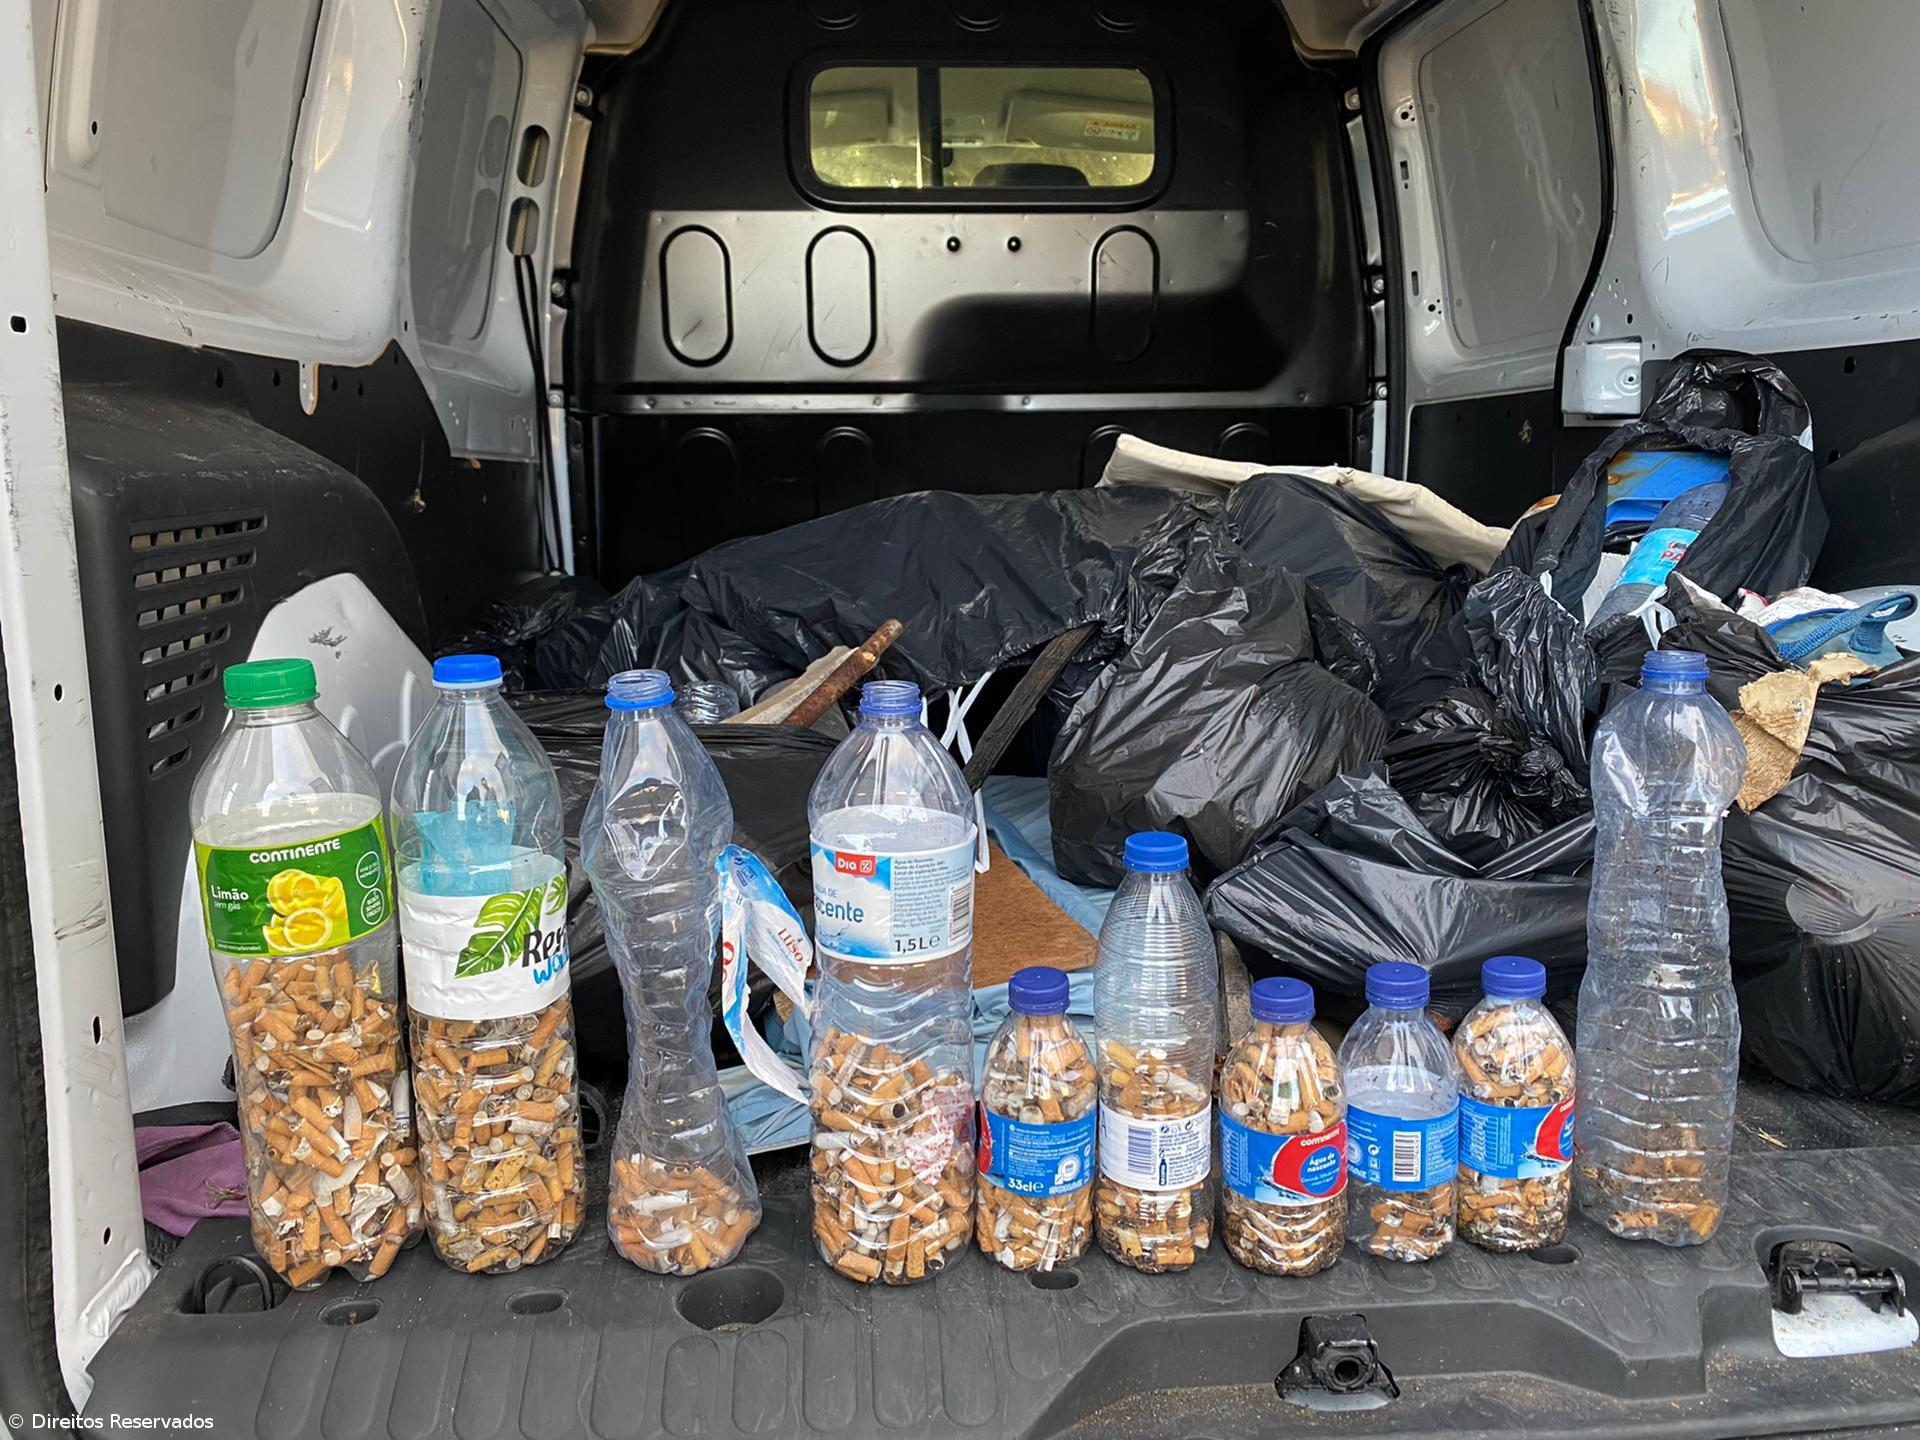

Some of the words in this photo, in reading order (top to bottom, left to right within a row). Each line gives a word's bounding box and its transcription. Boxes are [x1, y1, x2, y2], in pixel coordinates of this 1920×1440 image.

[210, 884, 249, 901] Limão
[828, 887, 838, 898] DE
[1307, 1158, 1337, 1173] nascente
[1309, 1155, 1327, 1166] Água
[1327, 1151, 1335, 1160] de
[1008, 1177, 1032, 1192] 33cl
